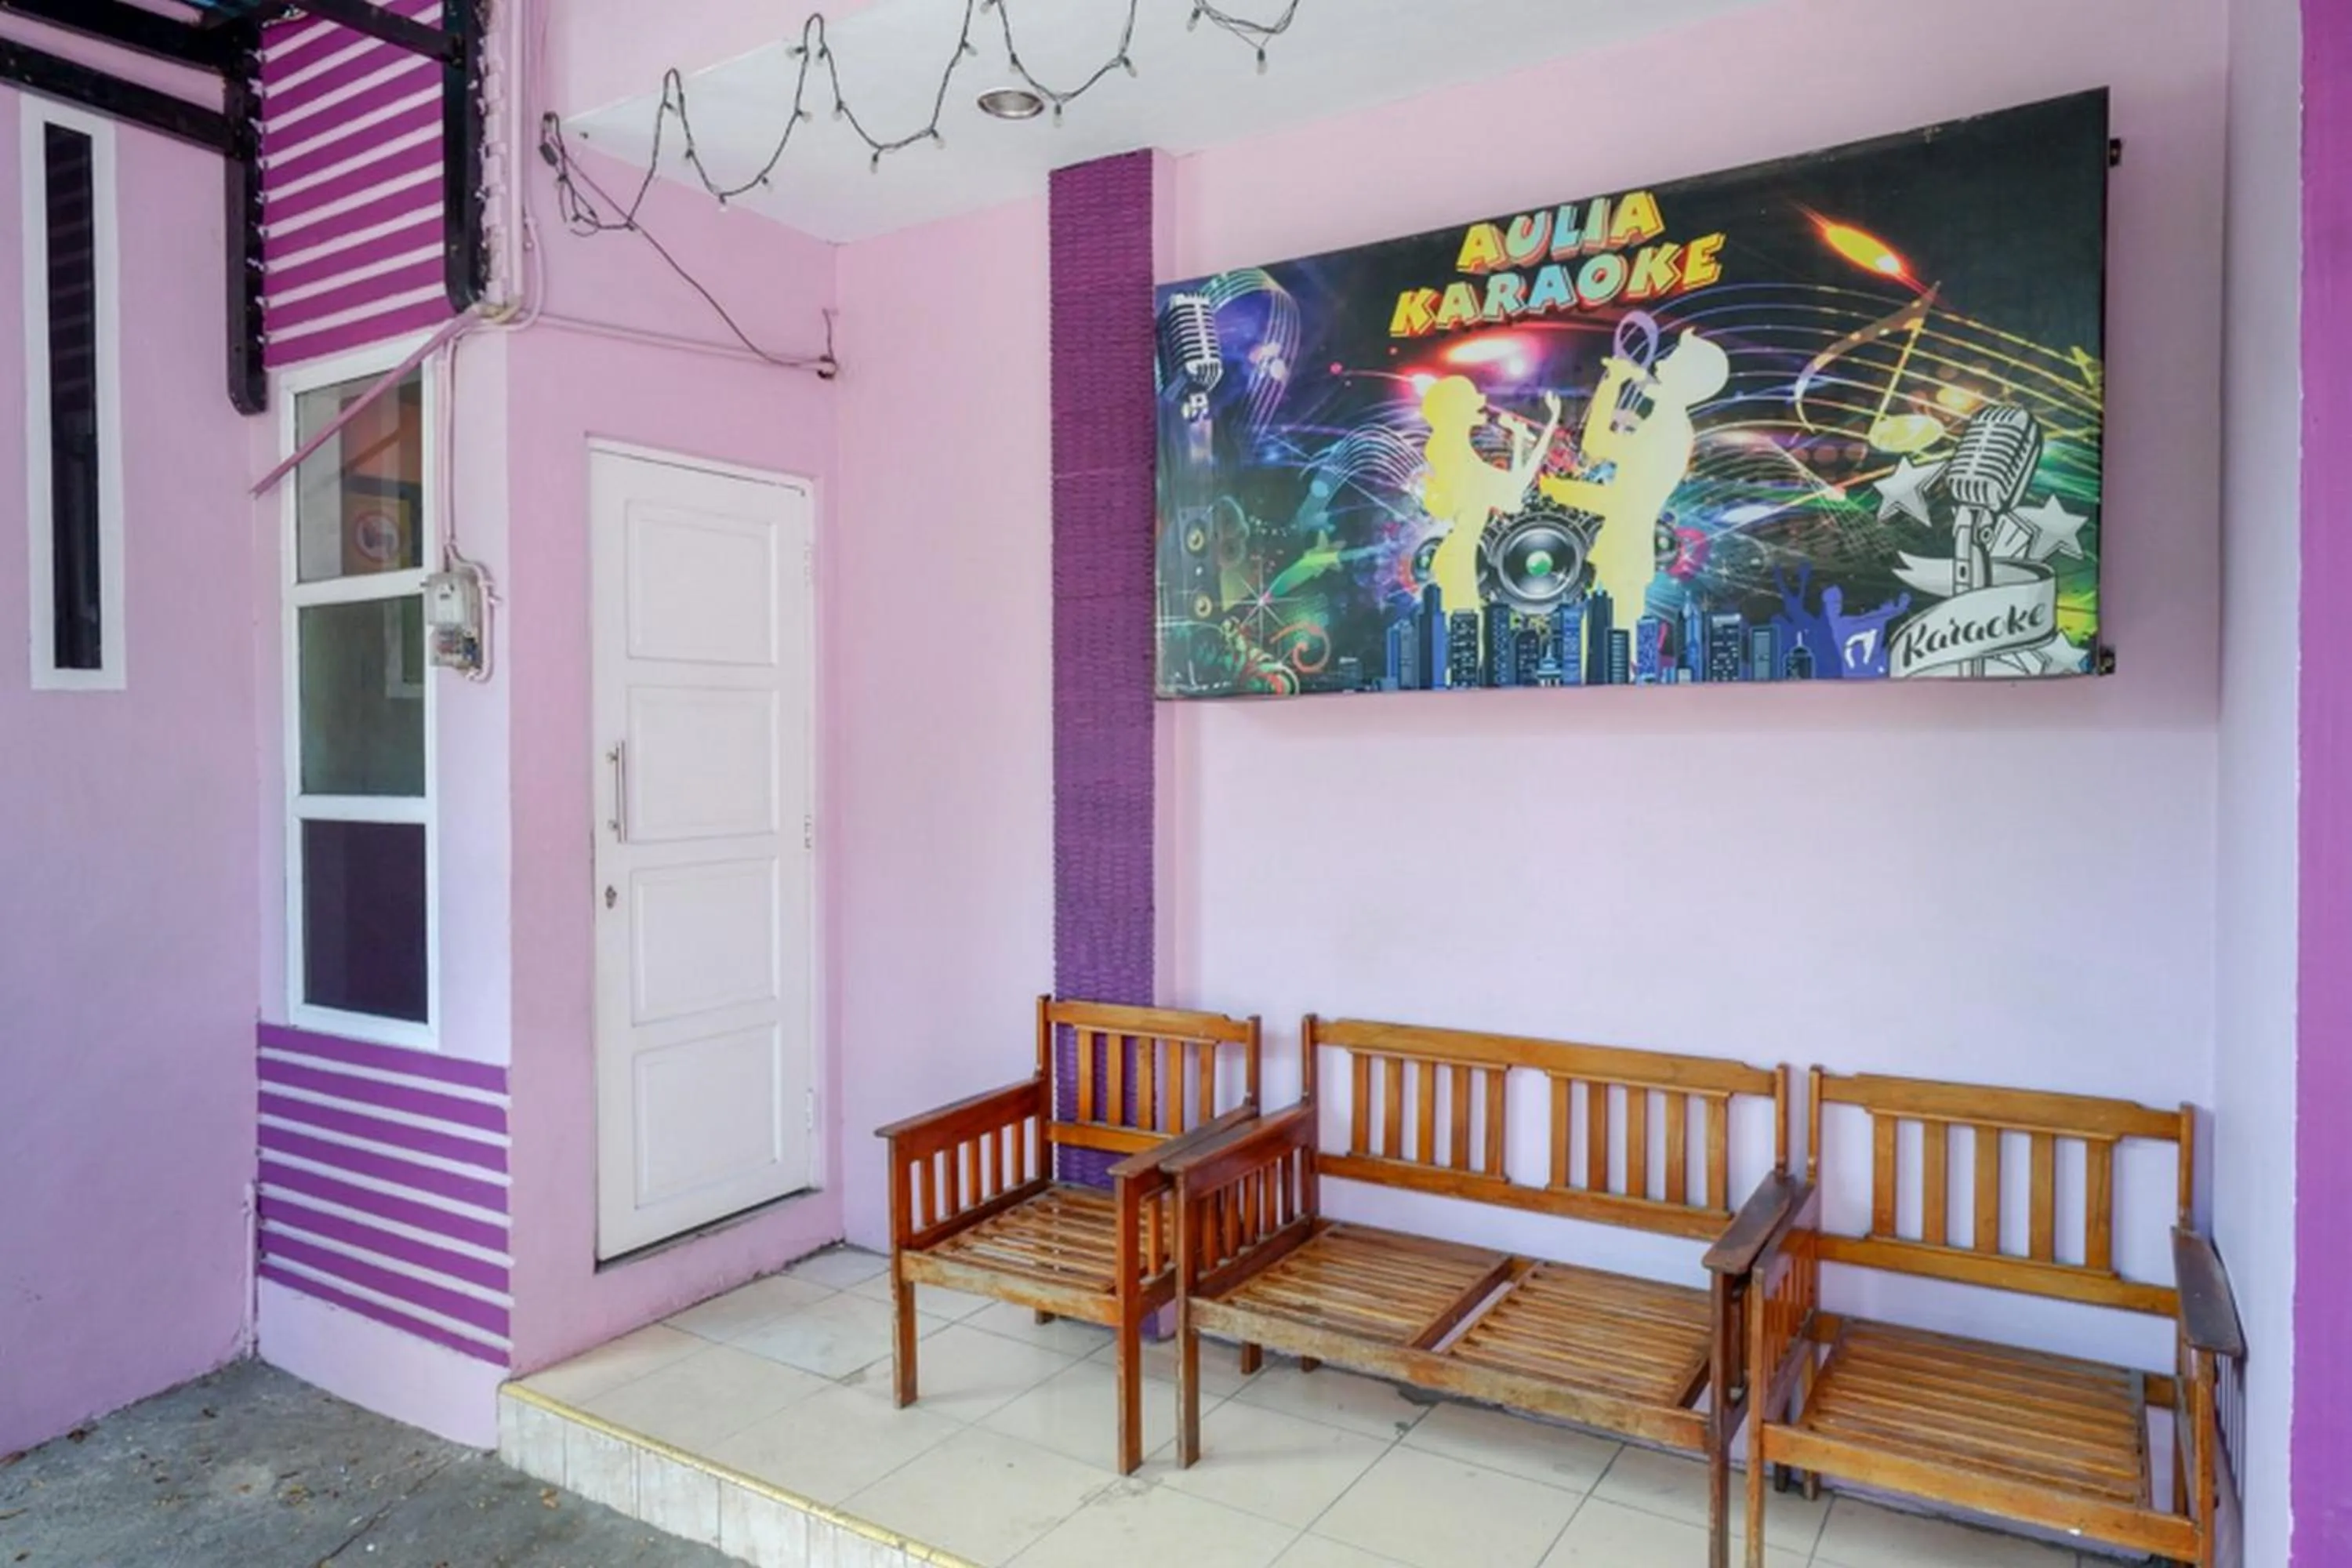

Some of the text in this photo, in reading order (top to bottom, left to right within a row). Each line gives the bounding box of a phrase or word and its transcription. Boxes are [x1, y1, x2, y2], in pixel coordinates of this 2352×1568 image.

[1456, 191, 1665, 272] AULIA
[1390, 233, 1726, 337] KARAOKE
[1903, 603, 2045, 666] Karaoke
